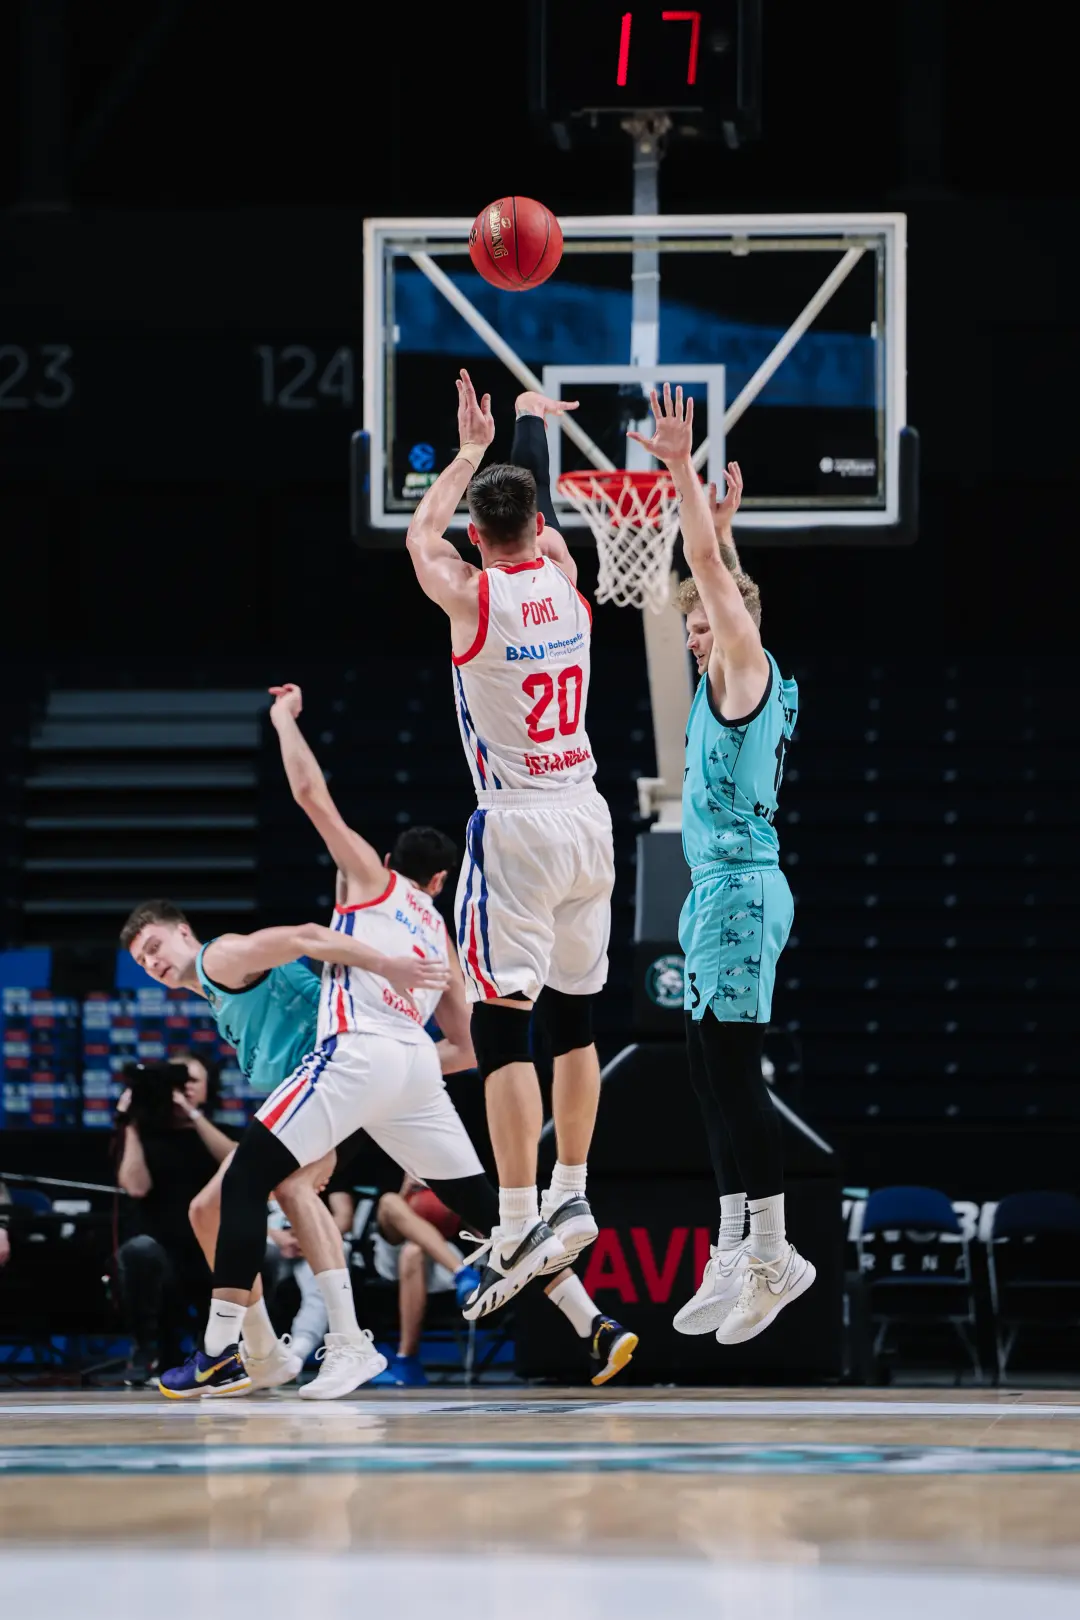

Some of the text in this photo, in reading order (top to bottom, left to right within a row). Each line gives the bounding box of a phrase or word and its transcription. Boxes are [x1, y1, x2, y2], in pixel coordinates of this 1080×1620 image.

[617, 11, 700, 86] 17
[253, 345, 354, 409] 124
[506, 645, 545, 661] BAU
[522, 664, 582, 744] 20
